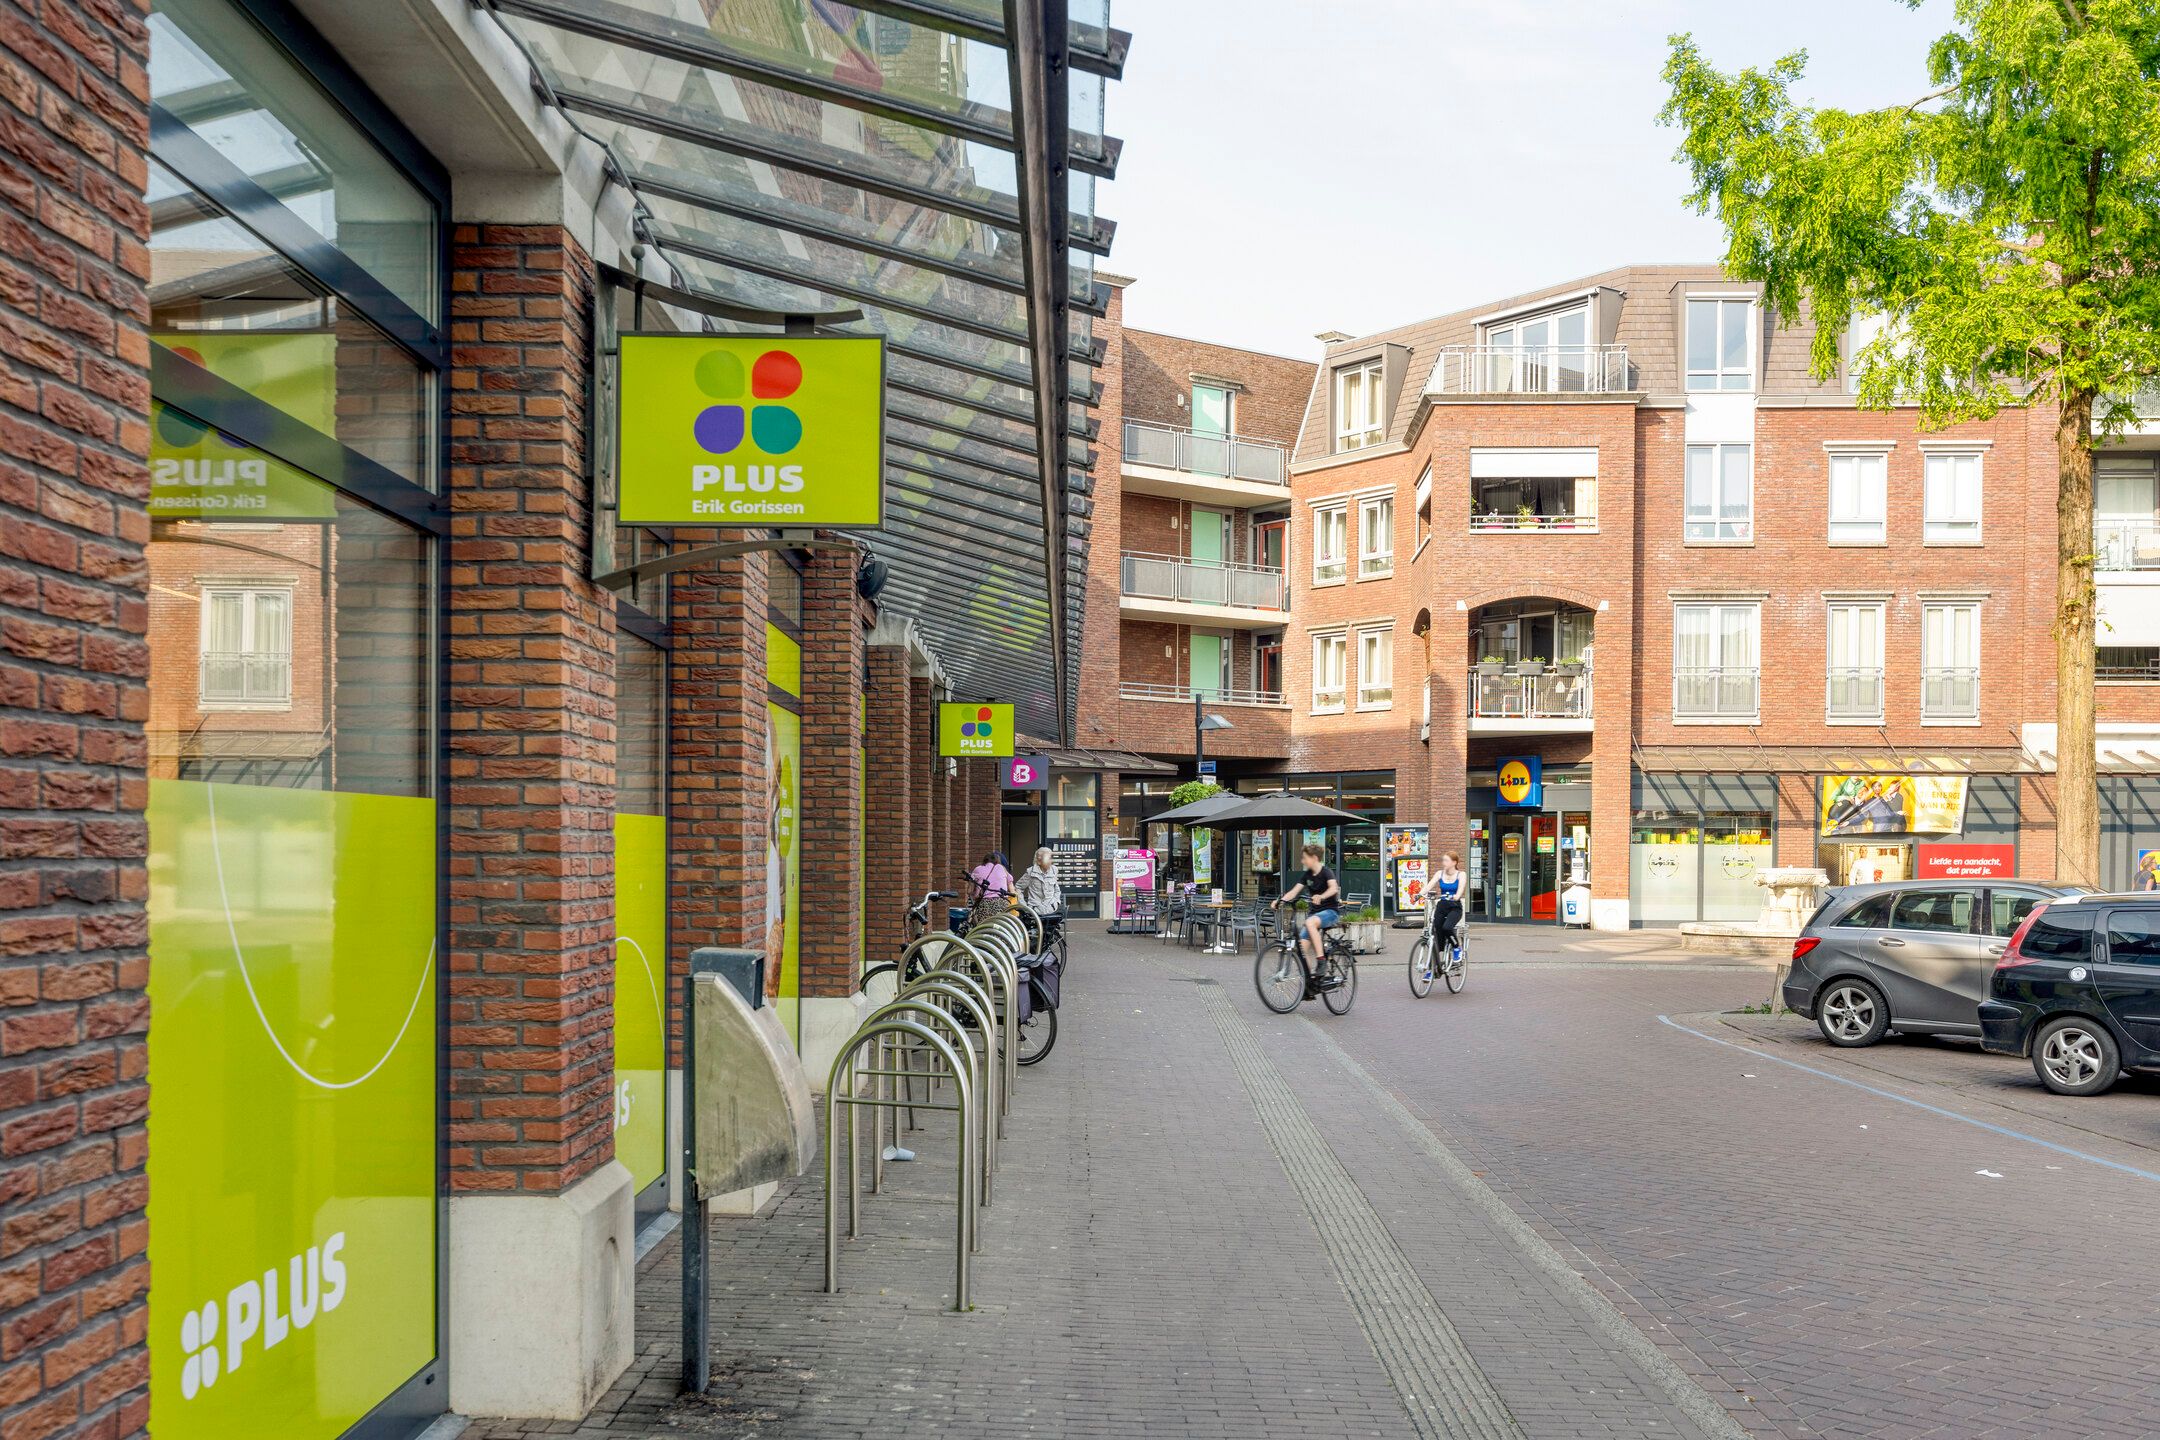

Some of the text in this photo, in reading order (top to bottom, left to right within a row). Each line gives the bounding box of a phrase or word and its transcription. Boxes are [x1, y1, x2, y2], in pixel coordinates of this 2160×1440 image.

[692, 464, 804, 492] PLUS
[692, 499, 805, 514] Erik Gorissen
[960, 739, 993, 748] PLUS
[1013, 764, 1031, 783] B
[1929, 857, 2002, 867] Liefde en aandacht,
[1945, 866, 1992, 876] dat proef je.
[226, 1231, 347, 1375] PLUS
